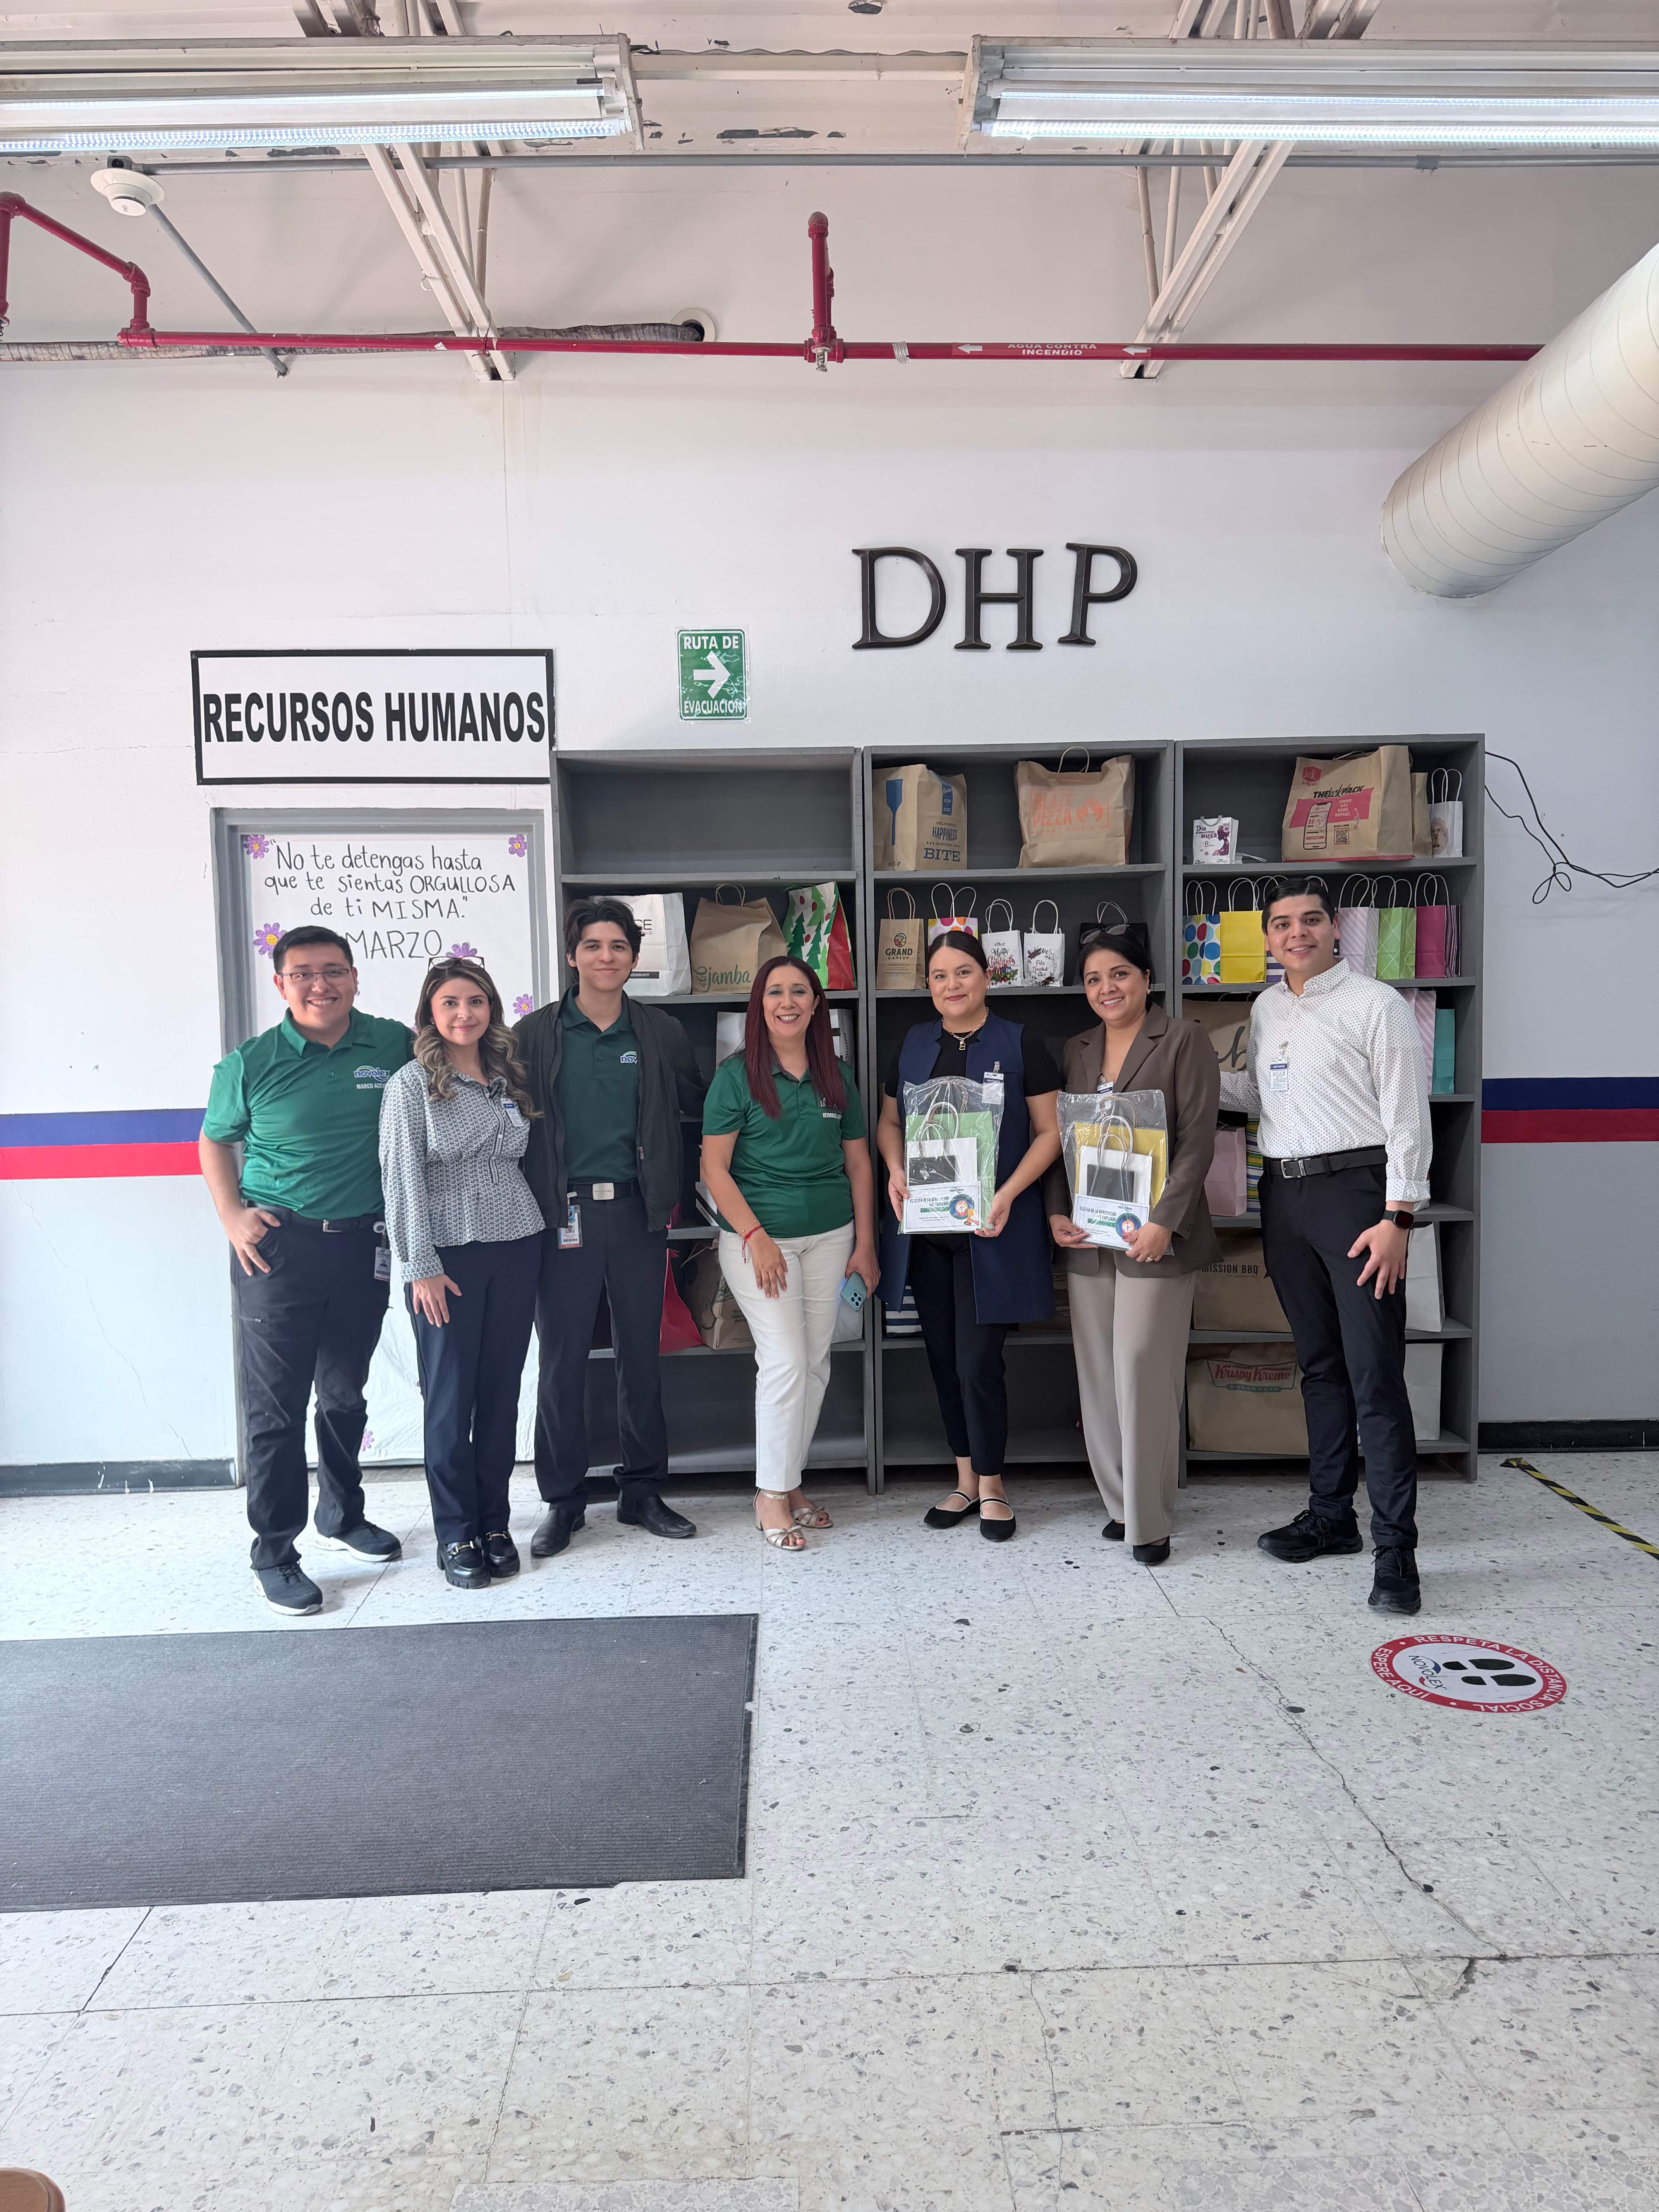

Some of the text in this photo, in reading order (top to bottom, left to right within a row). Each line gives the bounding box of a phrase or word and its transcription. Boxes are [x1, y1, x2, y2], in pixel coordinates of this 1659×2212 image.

[851, 543, 1138, 650] DHP
[684, 636, 738, 649] RUTA DE
[203, 691, 544, 742] RECURSOS HUMANOS
[1304, 768, 1317, 780] Jack
[1034, 793, 1072, 811] BLAZE
[1032, 808, 1072, 828] PIZZA
[933, 827, 957, 841] HAPPINESS
[311, 845, 335, 870] te
[342, 846, 424, 876] detengas
[432, 845, 482, 870] hasta
[923, 848, 960, 862] BITE
[265, 872, 515, 896] que te sientas ORGULLOSA
[311, 898, 333, 915] de
[345, 898, 362, 916] ti
[345, 930, 442, 959] MARZO
[991, 948, 1009, 958] Merry
[988, 955, 1015, 968] Christmas
[704, 965, 751, 993] jamba
[354, 1067, 390, 1078] novolex
[1242, 1265, 1258, 1274] BBQ
[1215, 1365, 1291, 1382] Krispy Kreme
[1374, 1648, 1431, 1699] ESPERE AQUÍ
[1408, 1655, 1447, 1690] NOVOLEX
[1413, 1635, 1563, 1712] RESPETA LA DISTANCIA SOCIAL
